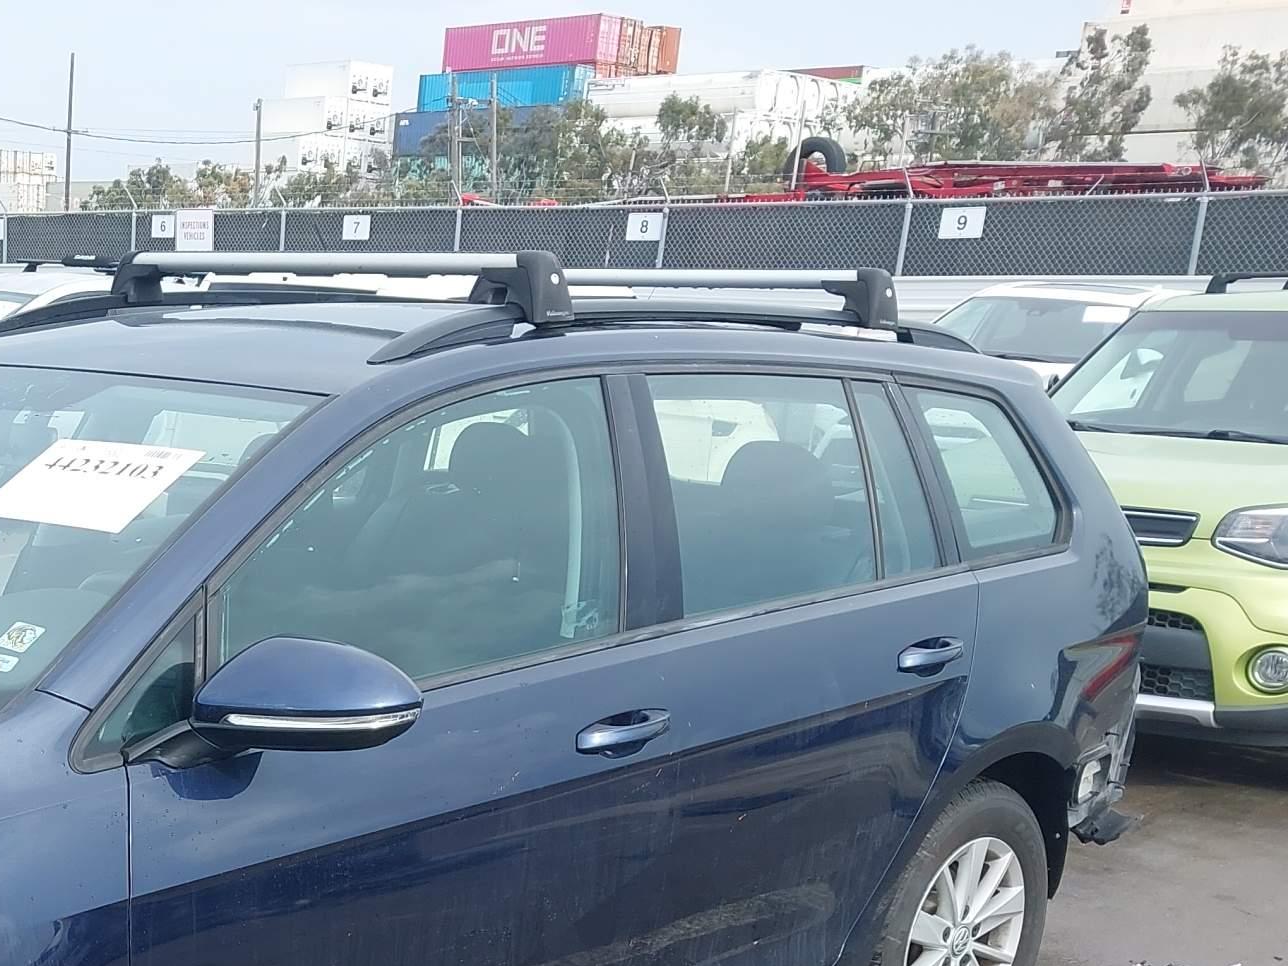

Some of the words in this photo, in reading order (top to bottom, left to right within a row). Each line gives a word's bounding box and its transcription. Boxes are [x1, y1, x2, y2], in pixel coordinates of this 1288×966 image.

[491, 25, 546, 55] ONE
[160, 220, 166, 232] 6
[353, 221, 361, 234] 7
[639, 219, 649, 234] 8
[956, 215, 968, 231] 9
[44, 456, 165, 479] 44232103
